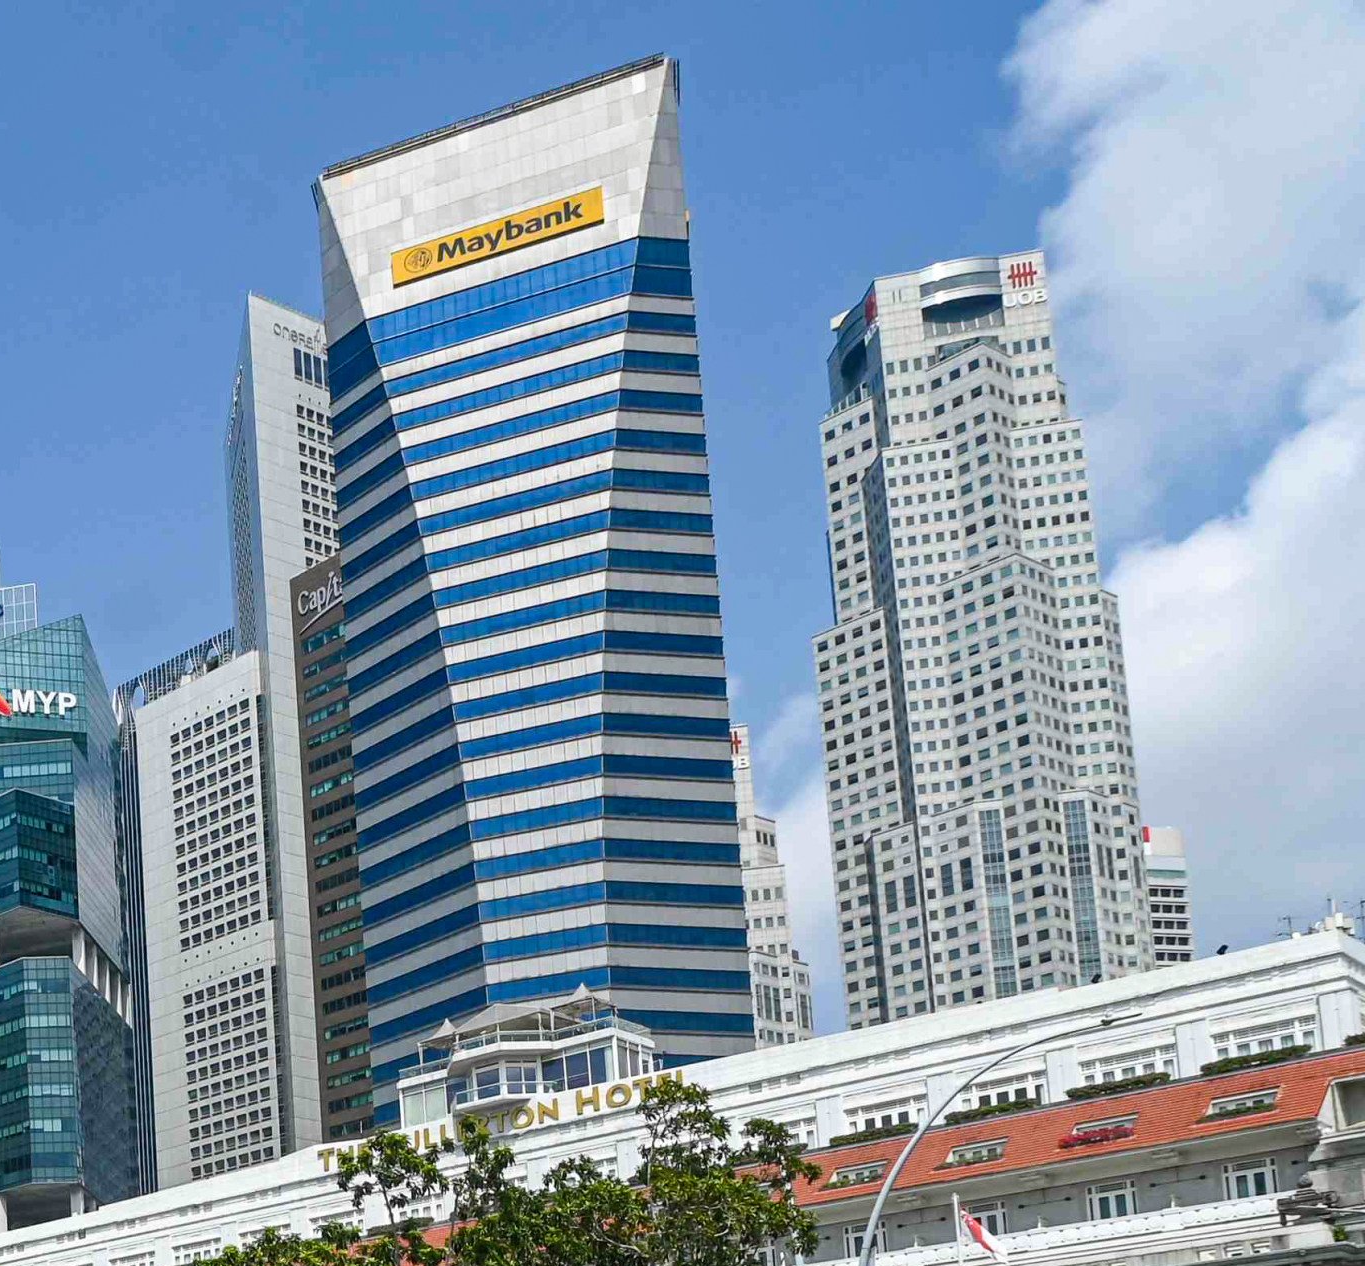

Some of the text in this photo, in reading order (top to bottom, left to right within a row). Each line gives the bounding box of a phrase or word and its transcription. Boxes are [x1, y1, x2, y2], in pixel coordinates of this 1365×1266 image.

[437, 200, 584, 263] Maybank
[1002, 287, 1048, 309] UOB
[12, 688, 78, 717] MYP
